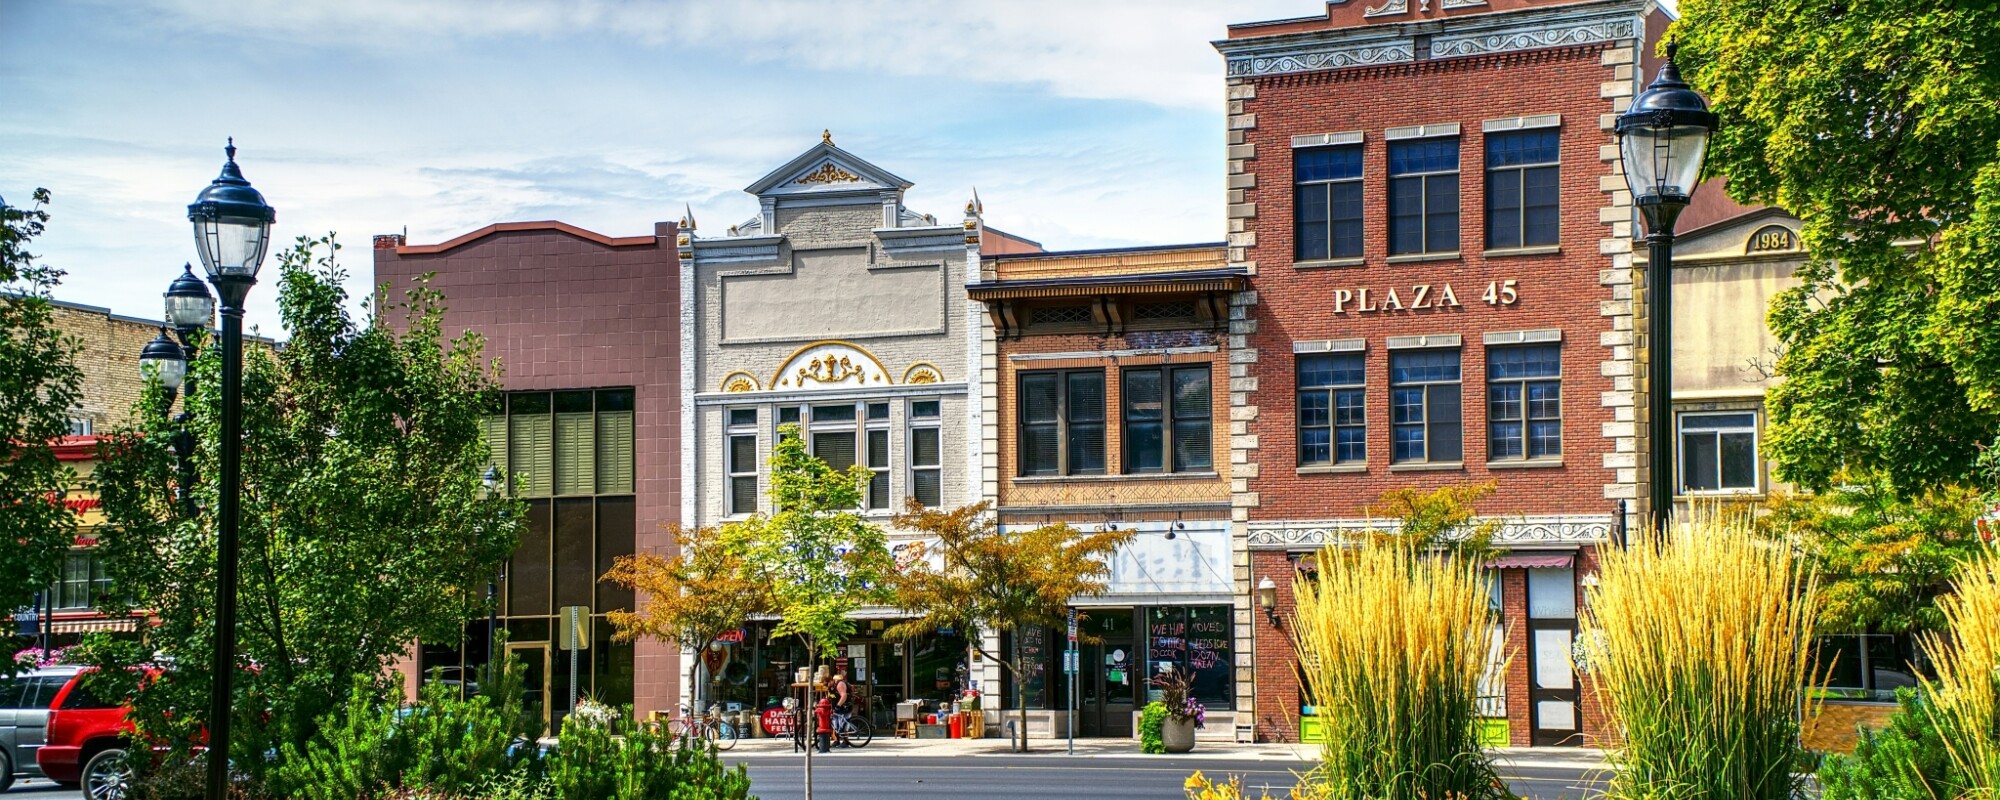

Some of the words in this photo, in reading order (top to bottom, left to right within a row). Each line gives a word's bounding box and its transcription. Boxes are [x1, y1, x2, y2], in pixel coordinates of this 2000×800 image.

[1754, 231, 1789, 250] 1984
[1333, 282, 1461, 313] PLAZA
[1482, 279, 1517, 305] 45
[1102, 618, 1114, 630] 41
[1151, 624, 1167, 635] WE
[716, 629, 744, 641] OPEN
[1160, 649, 1177, 659] COOK
